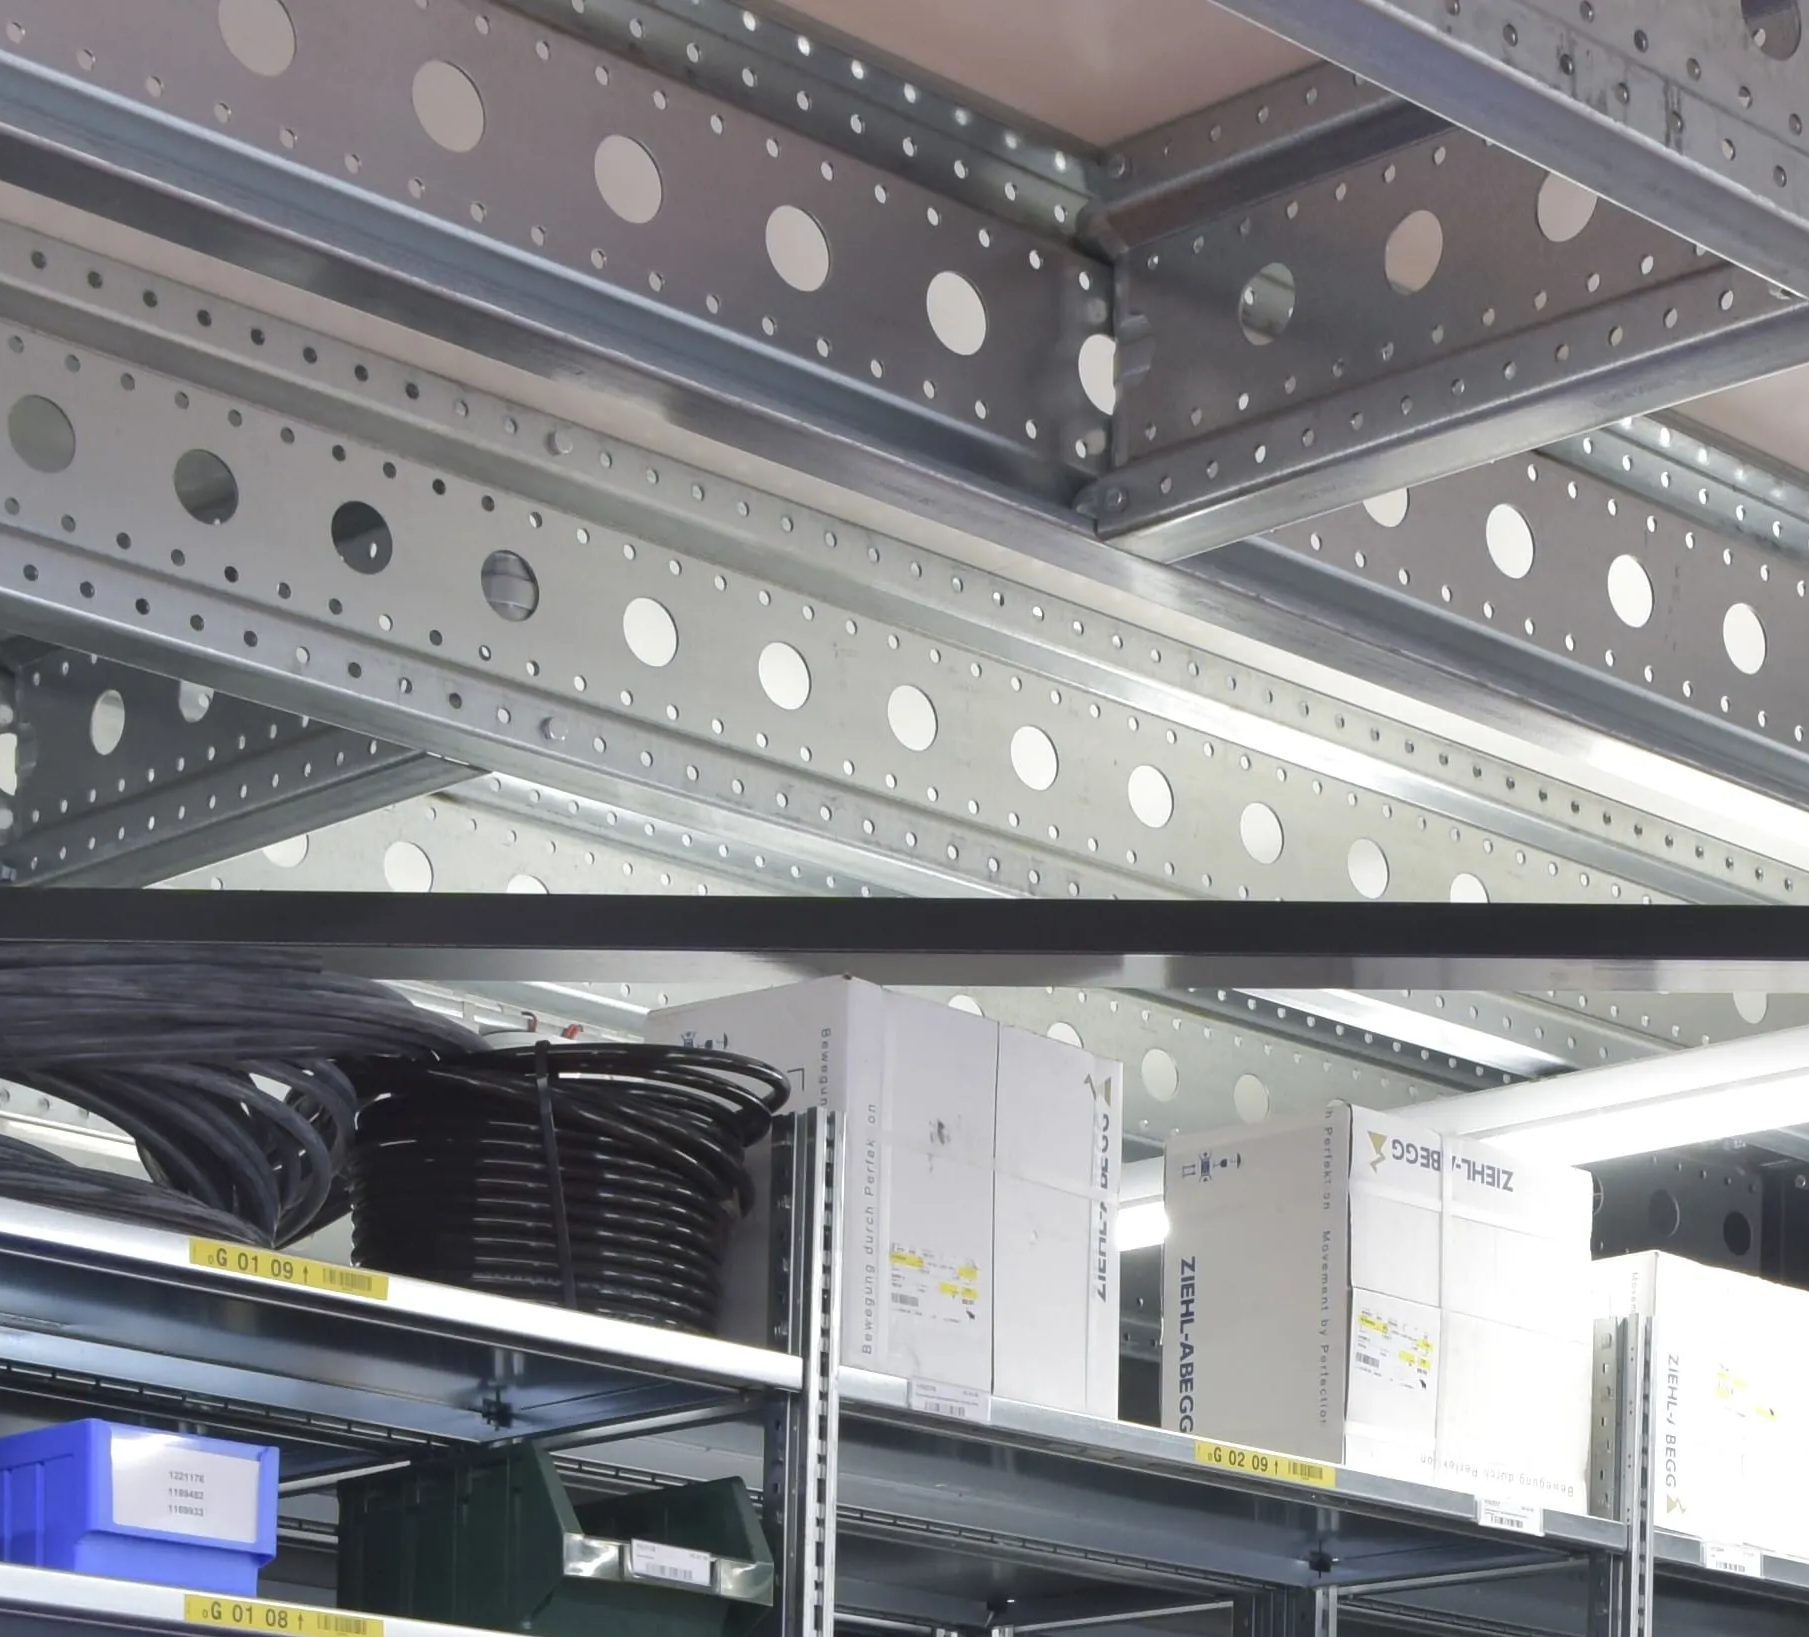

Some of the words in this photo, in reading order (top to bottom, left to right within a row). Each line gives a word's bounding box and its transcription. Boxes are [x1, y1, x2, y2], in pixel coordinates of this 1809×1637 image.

[819, 1027, 832, 1107] Bewegun
[863, 1103, 878, 1198] Perfekon
[863, 1200, 876, 1257] durch
[237, 1252, 259, 1273] 01
[270, 1258, 294, 1280] 09
[862, 1264, 877, 1355] Bewegung
[1178, 1255, 1197, 1433] ZIEHL-ABEGG
[1228, 1450, 1246, 1468] 02
[1251, 1454, 1269, 1473] 09
[232, 1603, 253, 1625] 01
[265, 1608, 288, 1629] 08
